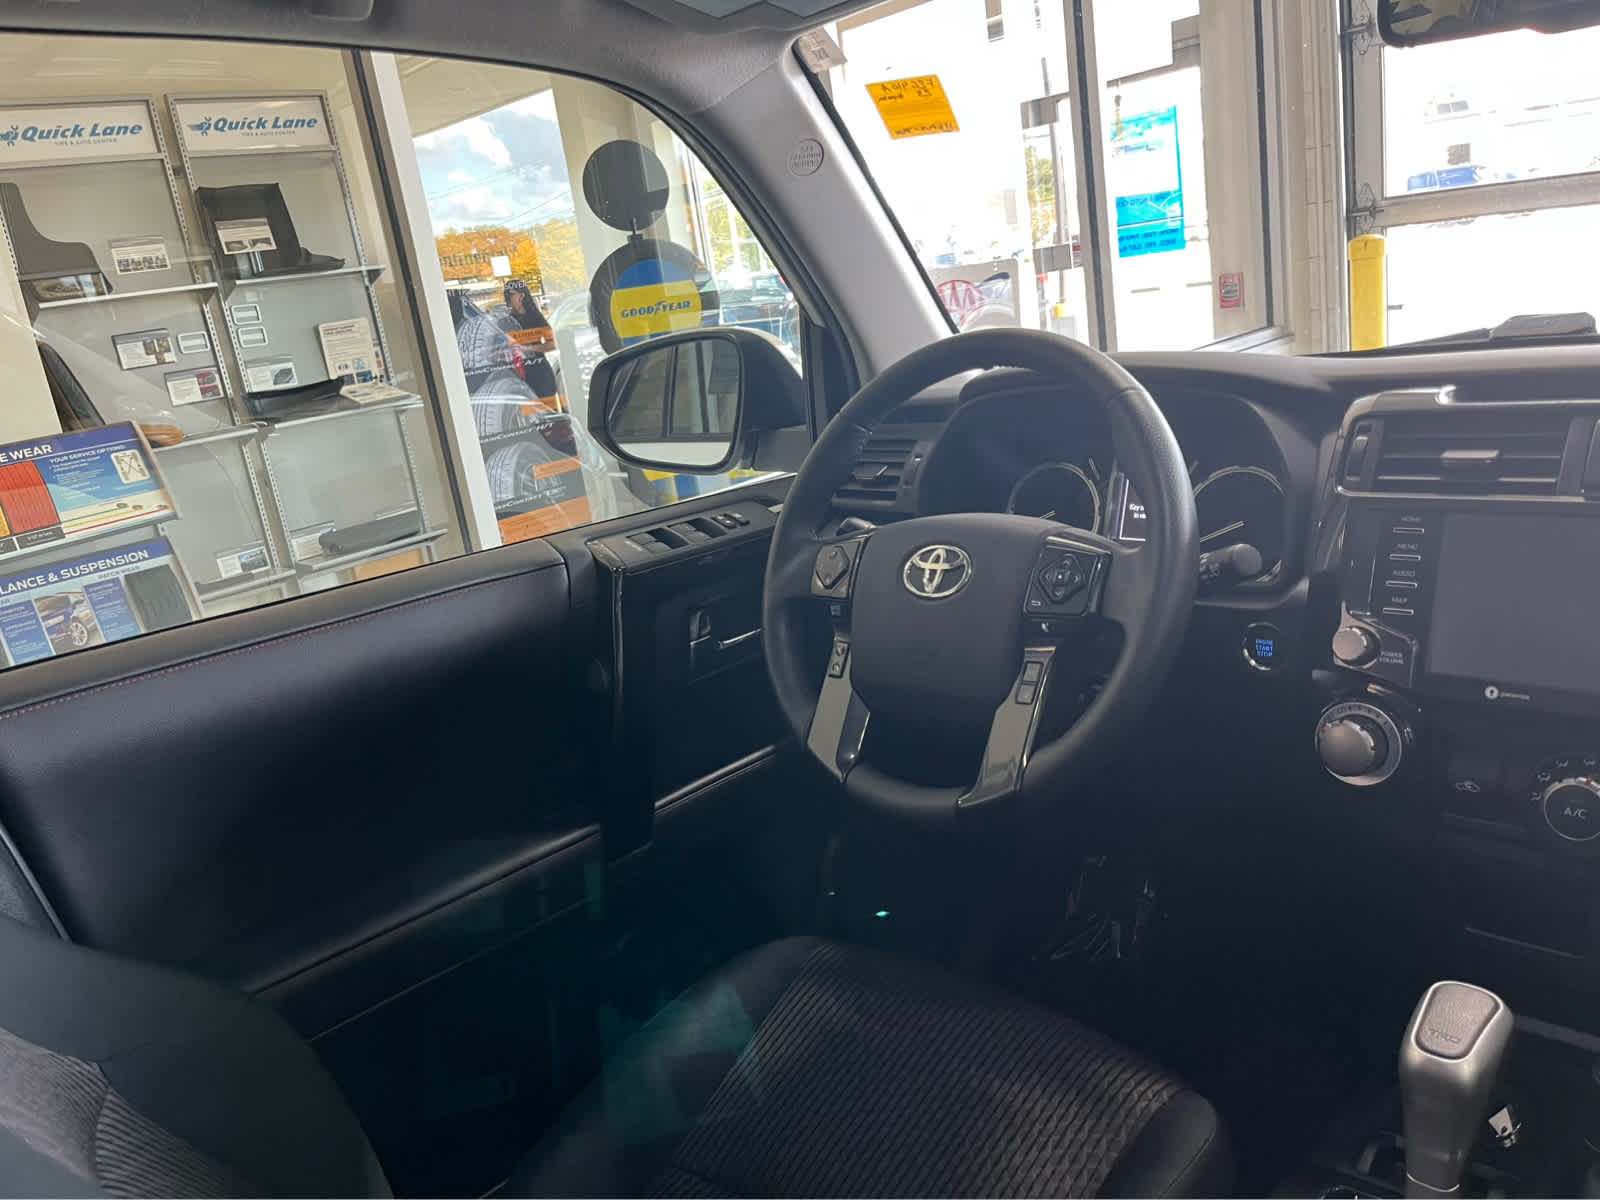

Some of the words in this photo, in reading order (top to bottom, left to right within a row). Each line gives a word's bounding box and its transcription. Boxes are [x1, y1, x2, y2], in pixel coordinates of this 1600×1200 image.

[21, 124, 85, 142] Quick
[89, 122, 143, 137] Lane
[213, 116, 268, 132] Quick
[272, 116, 318, 129] Lane
[621, 300, 691, 318] GOODYEAR
[0, 453, 9, 463] E
[9, 444, 53, 460] WEAR
[49, 455, 69, 464] YOUR
[69, 449, 97, 460] SERVICE
[0, 577, 46, 594] LANCE
[48, 572, 59, 582] &
[60, 550, 149, 579] SUSPENSION
[1563, 807, 1586, 819] A/C
